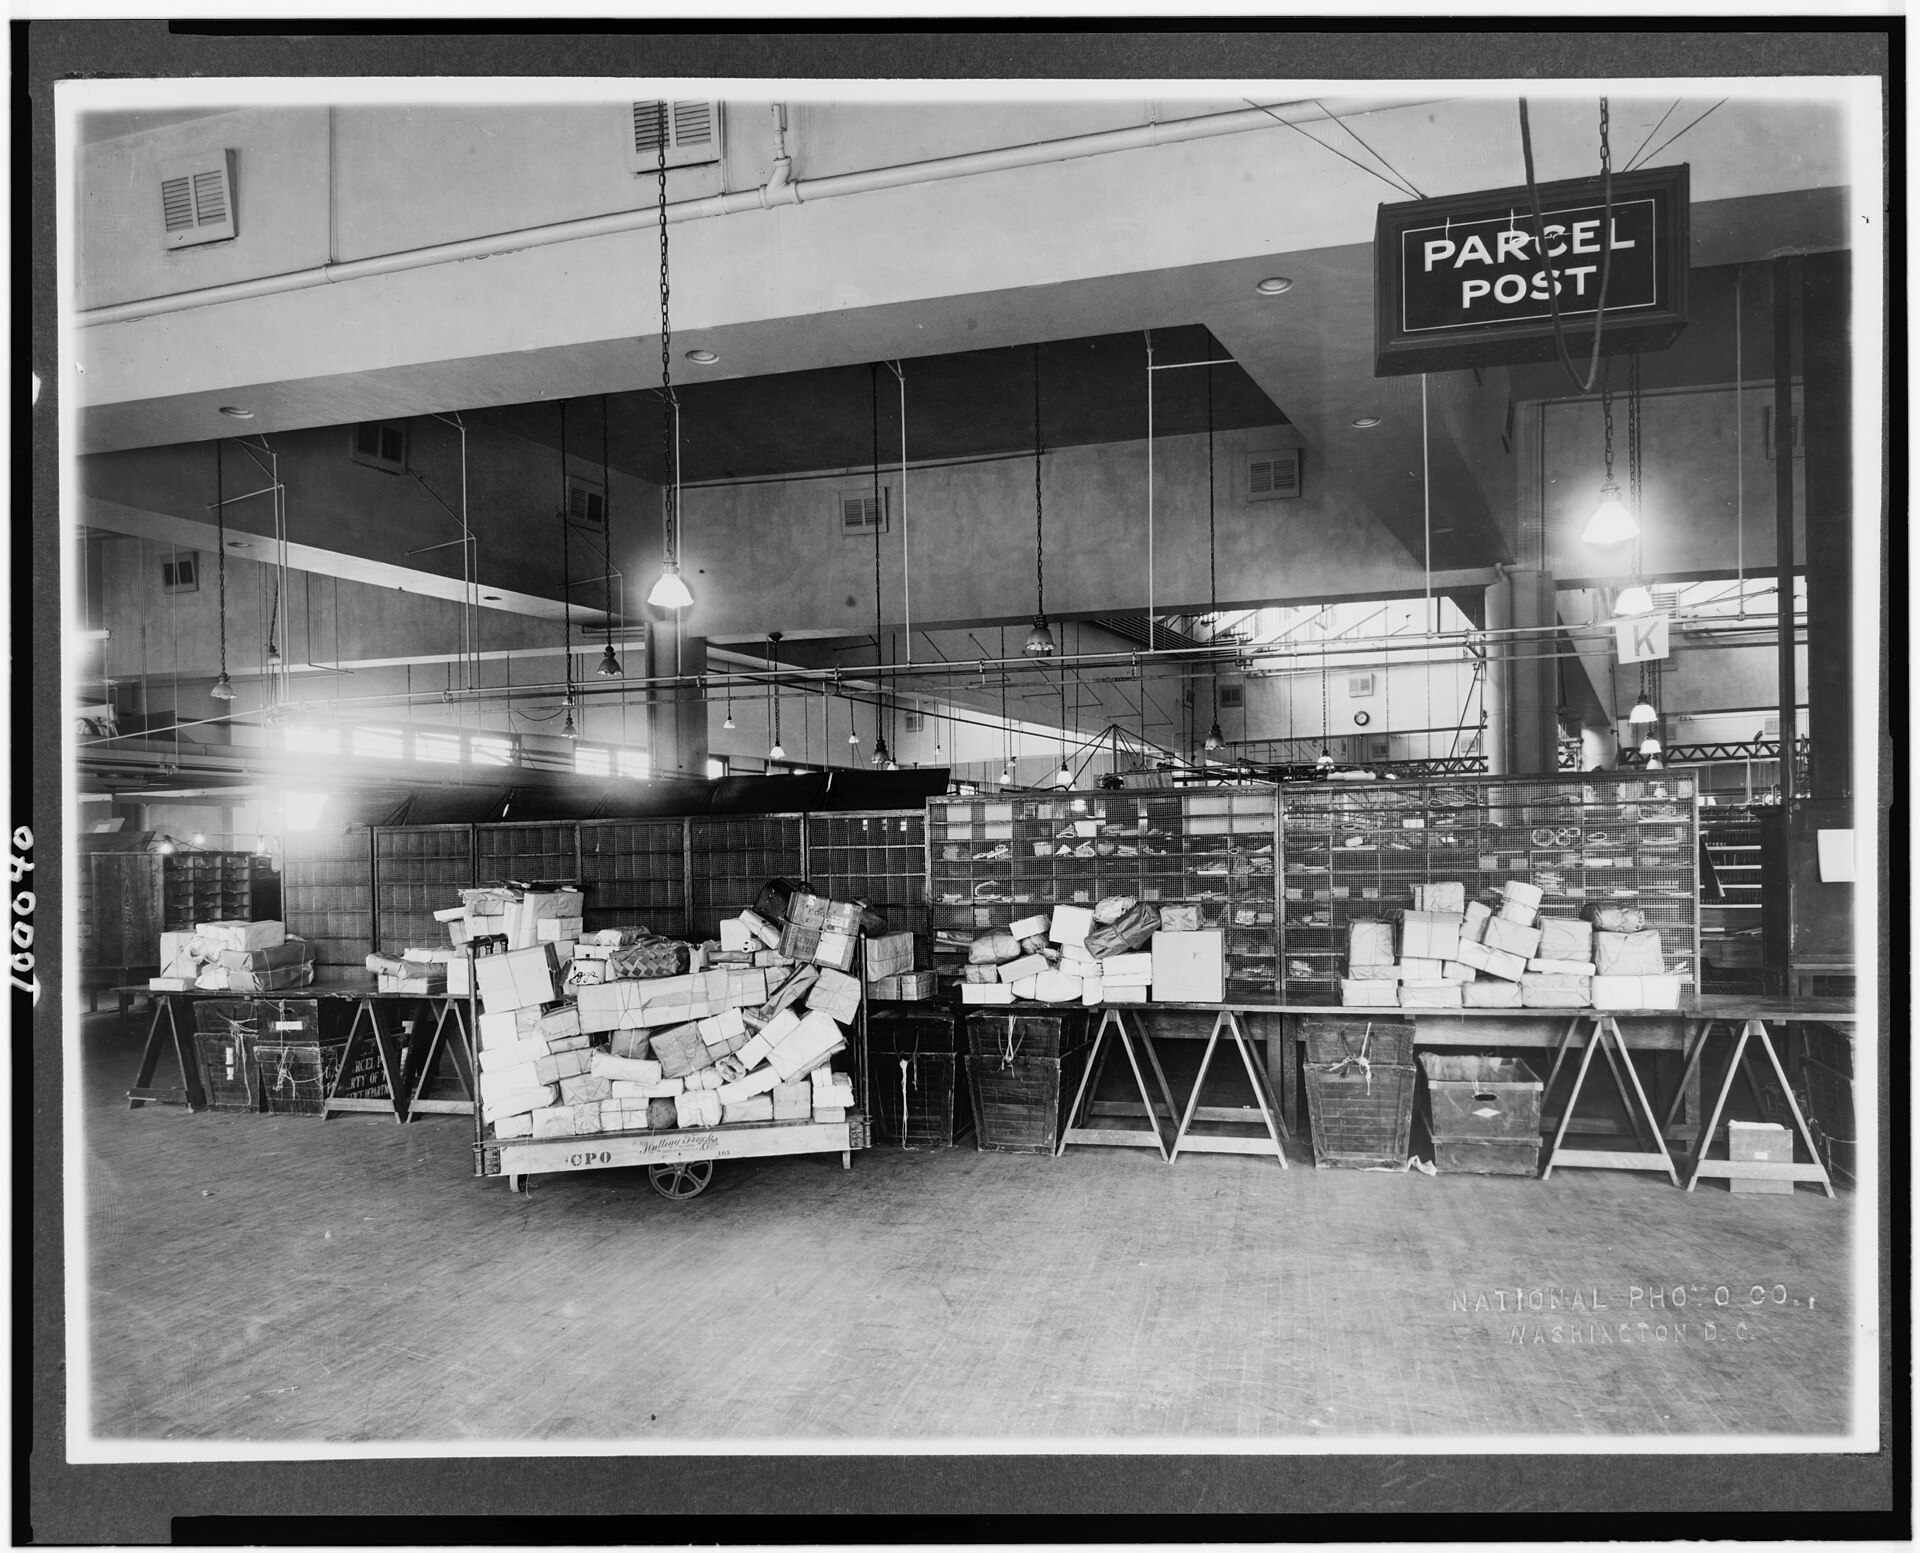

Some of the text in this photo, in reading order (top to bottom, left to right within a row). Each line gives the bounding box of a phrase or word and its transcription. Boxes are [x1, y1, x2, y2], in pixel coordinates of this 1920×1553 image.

[1424, 218, 1636, 272] PARCEL
[1461, 265, 1598, 310] POST
[1633, 621, 1659, 656] K
[353, 1057, 375, 1073] RCEL
[369, 1071, 379, 1084] OF
